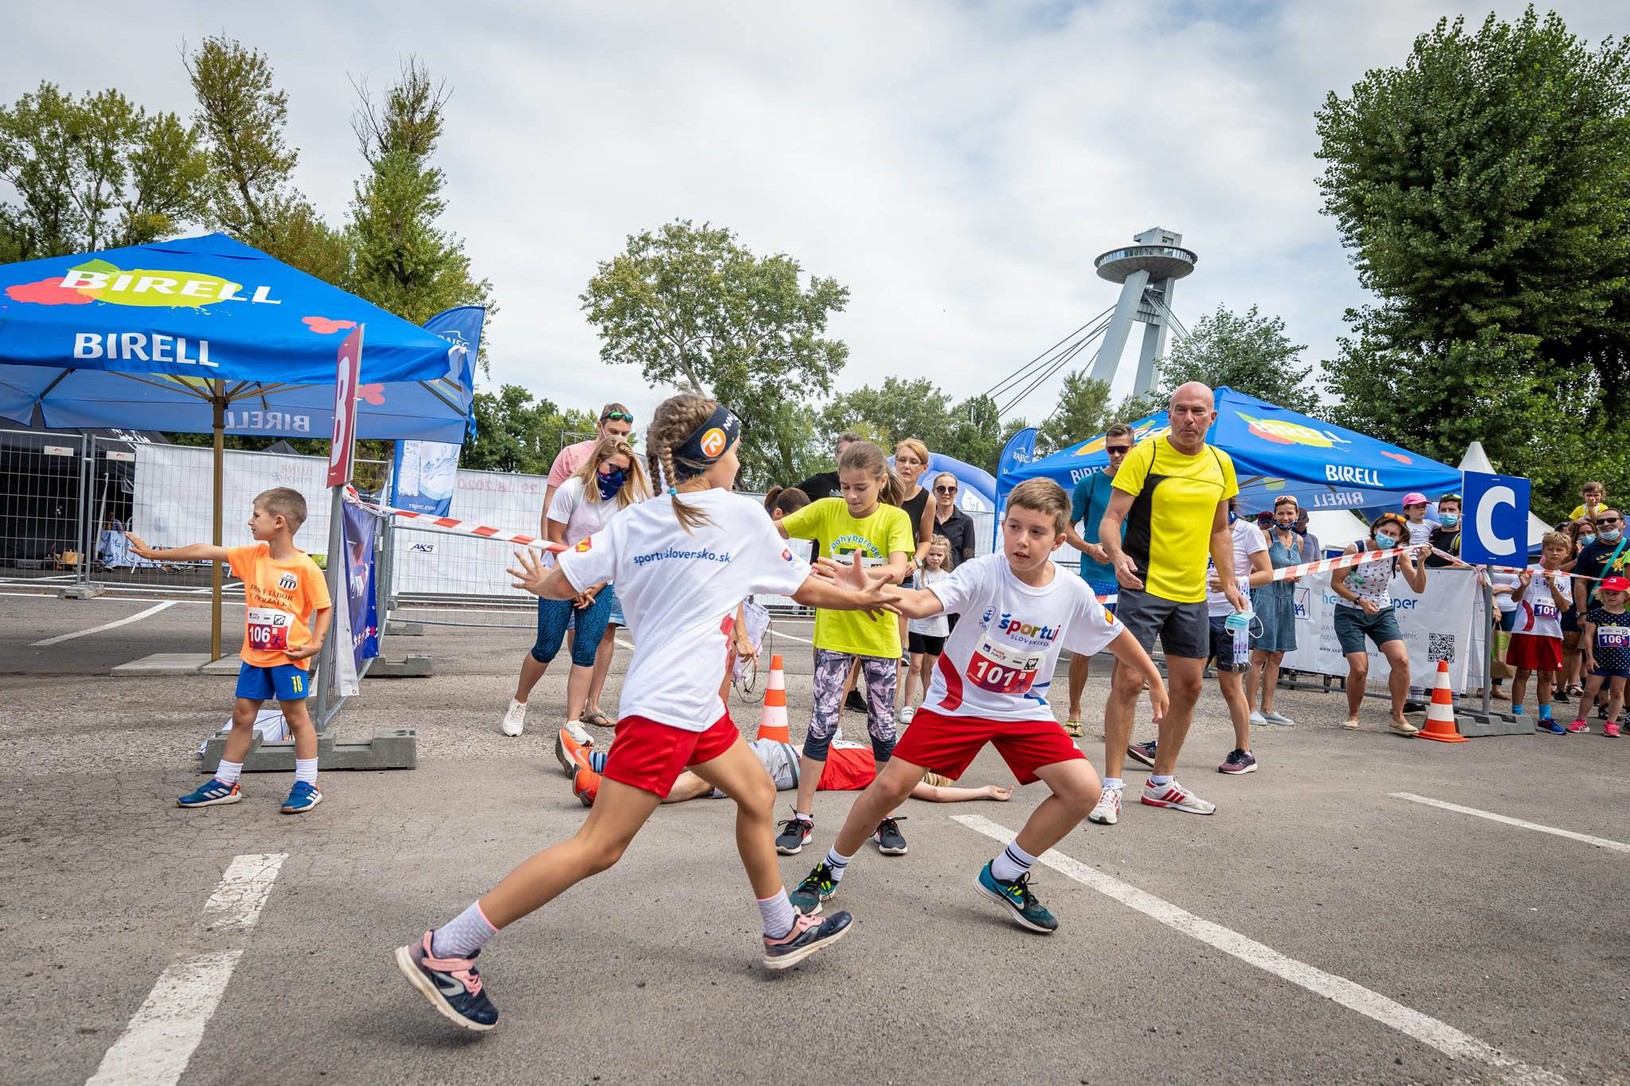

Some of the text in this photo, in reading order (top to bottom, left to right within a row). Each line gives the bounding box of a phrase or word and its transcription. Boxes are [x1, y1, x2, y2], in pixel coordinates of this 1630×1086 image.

[59, 270, 282, 304] BIRELL
[73, 332, 220, 368] BIRELL
[331, 356, 350, 468] B
[1325, 464, 1384, 487] BIRELL
[1476, 485, 1516, 556] C
[410, 543, 435, 552] AKS
[1538, 606, 1554, 615] 101
[249, 626, 271, 643] 106
[998, 613, 1061, 643] športuj
[1602, 635, 1622, 644] 106
[976, 660, 1016, 687] 101
